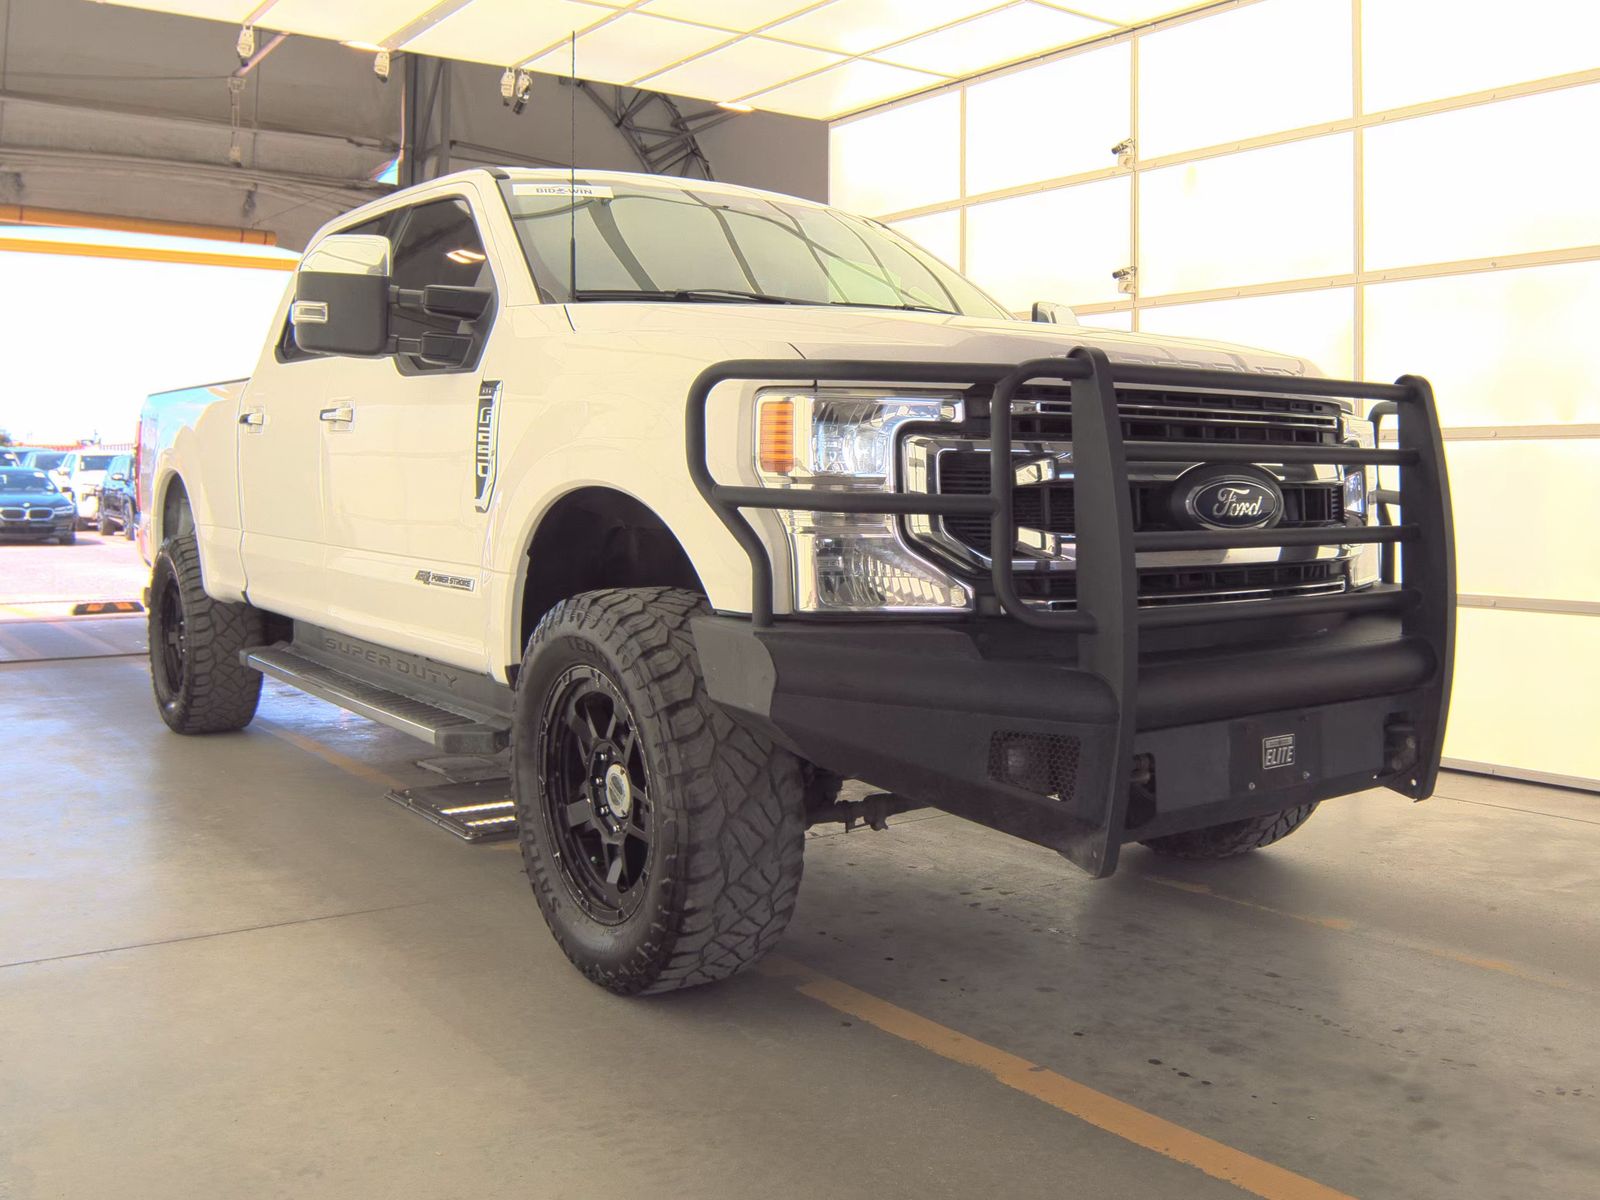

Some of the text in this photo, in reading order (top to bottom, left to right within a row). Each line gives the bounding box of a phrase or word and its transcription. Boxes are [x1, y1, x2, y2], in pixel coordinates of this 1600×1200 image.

[1212, 487, 1263, 518] Ford
[432, 575, 449, 584] POWER
[449, 577, 471, 587] STROKE
[325, 637, 458, 689] SUPER DUTY
[1265, 745, 1294, 766] ELITE
[518, 804, 561, 913] SAILUN
